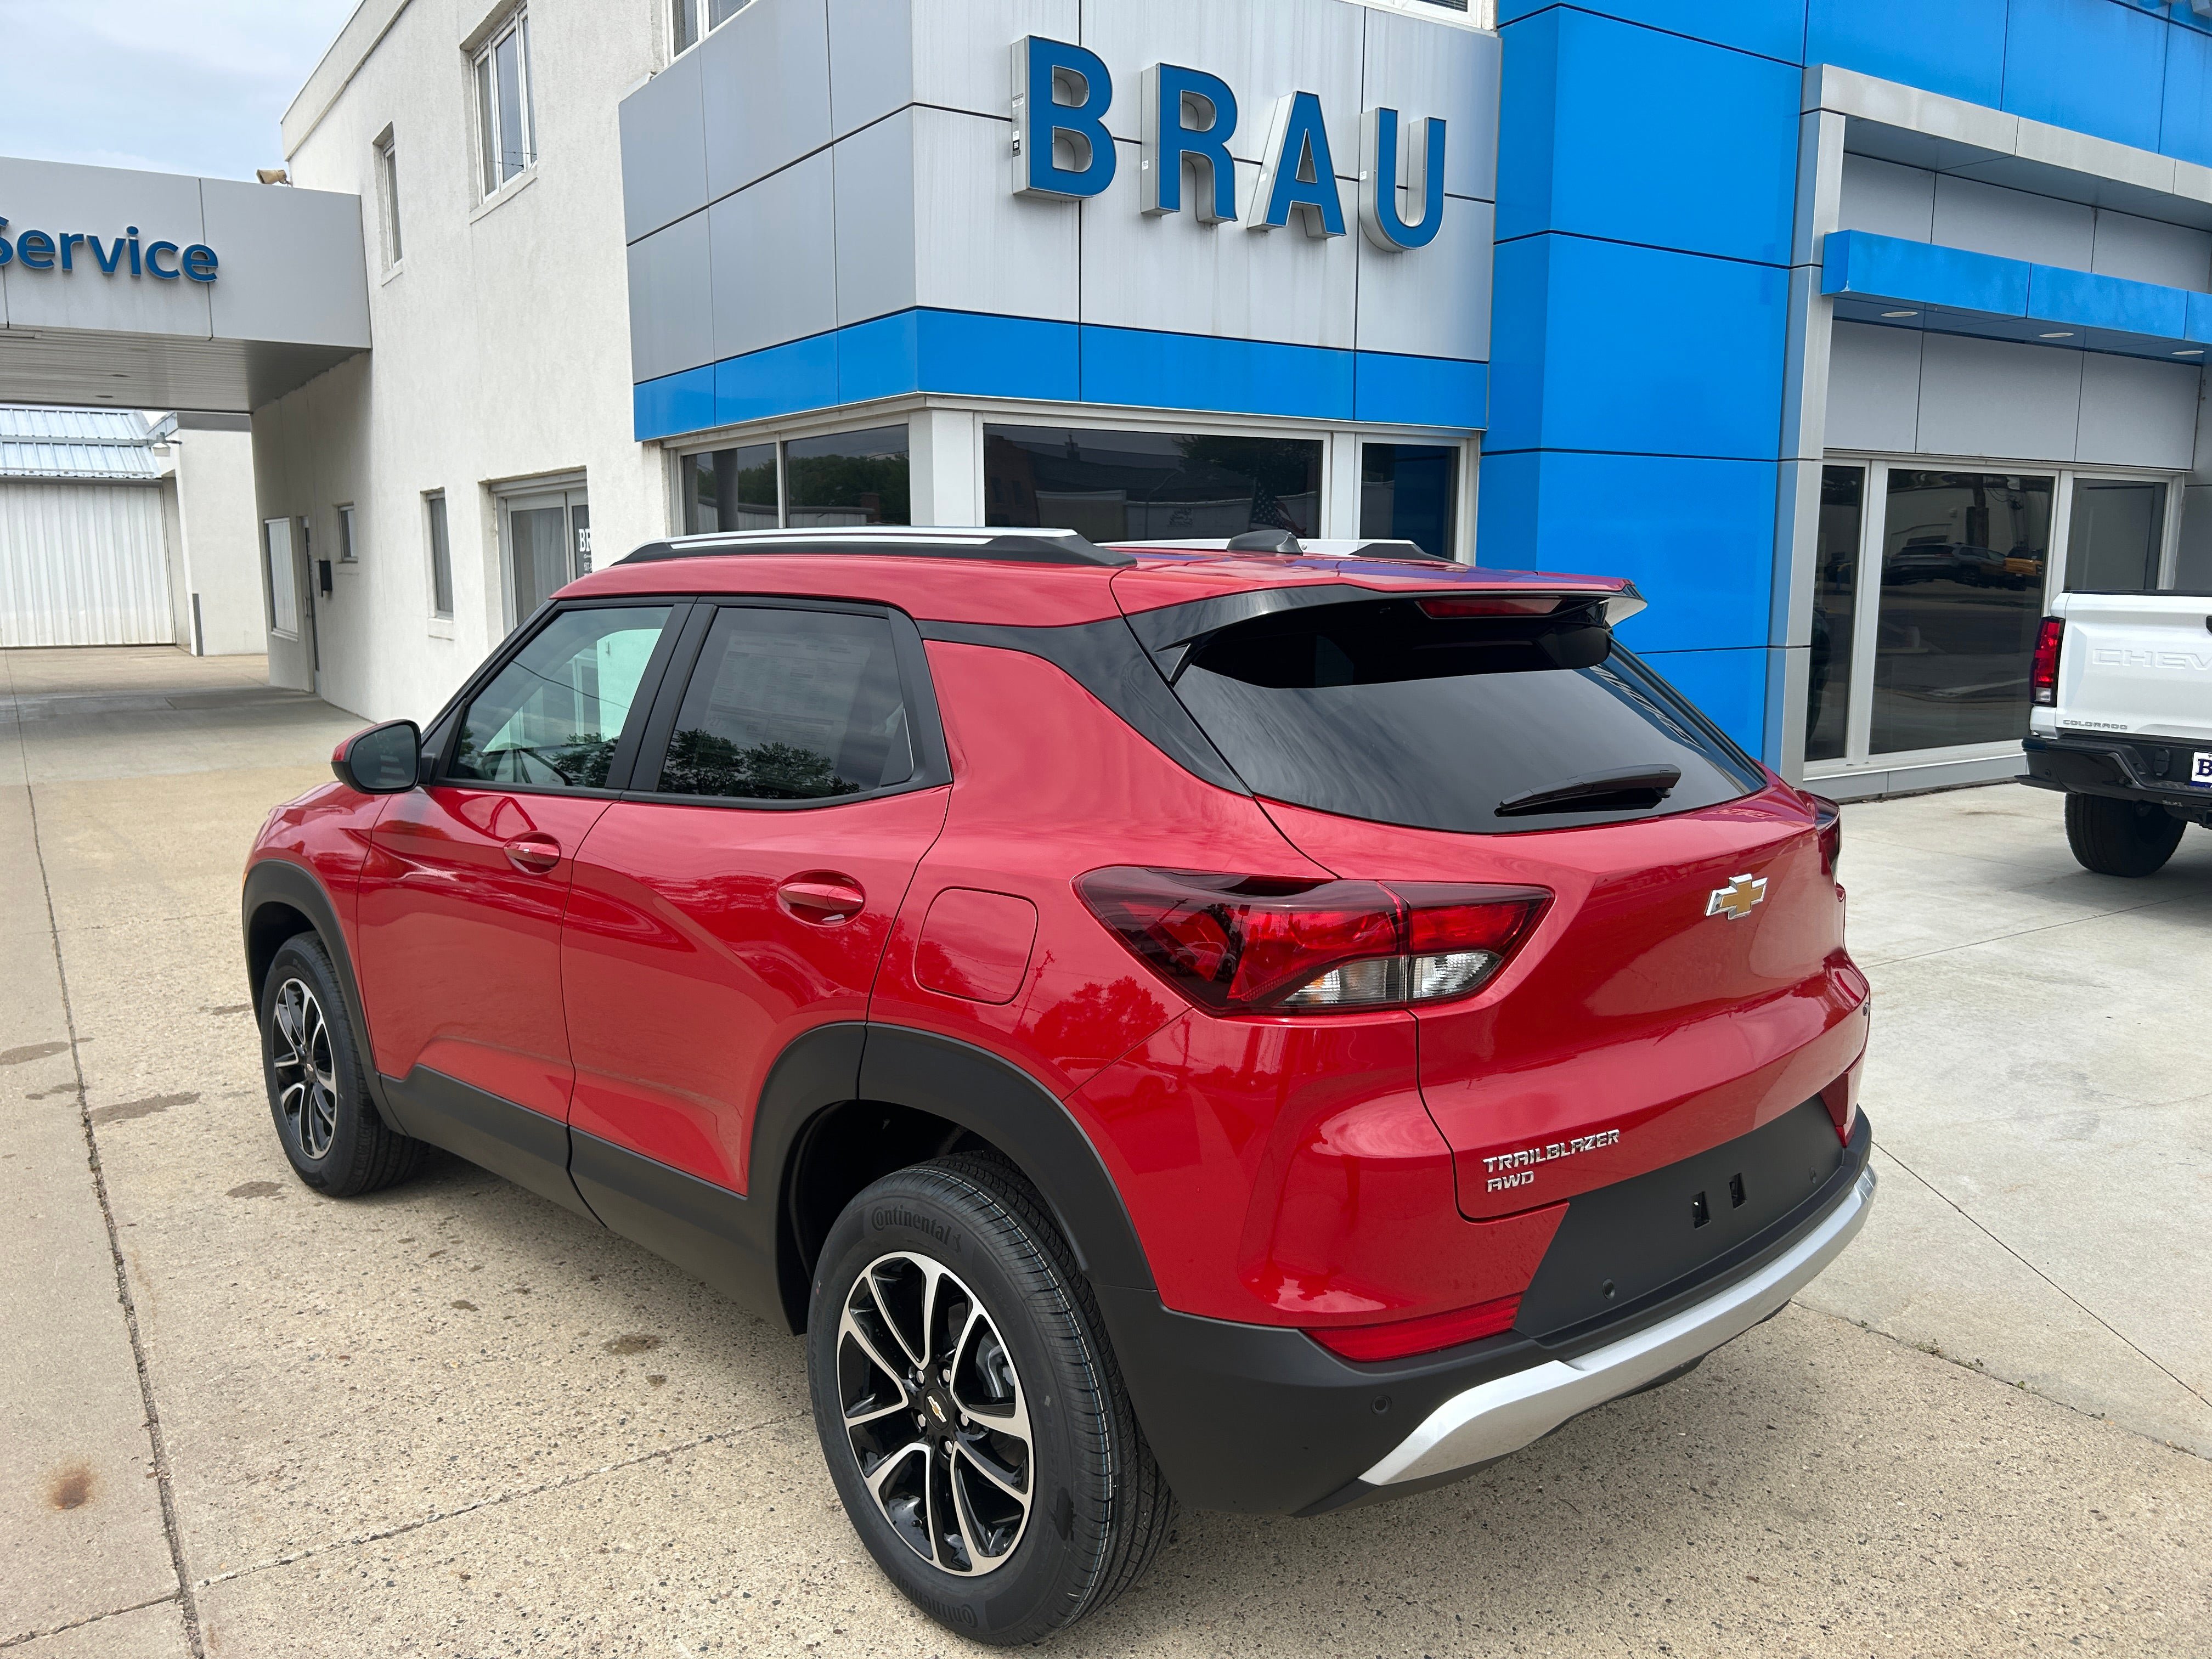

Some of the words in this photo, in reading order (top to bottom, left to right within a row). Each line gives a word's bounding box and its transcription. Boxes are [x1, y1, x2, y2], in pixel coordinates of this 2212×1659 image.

[1012, 35, 1447, 252] BRAU
[2063, 719, 2128, 730] COLORADO
[1482, 1129, 1621, 1173] TRAILBLAZER
[1487, 1171, 1534, 1193] AWD
[871, 1204, 952, 1246] Continental
